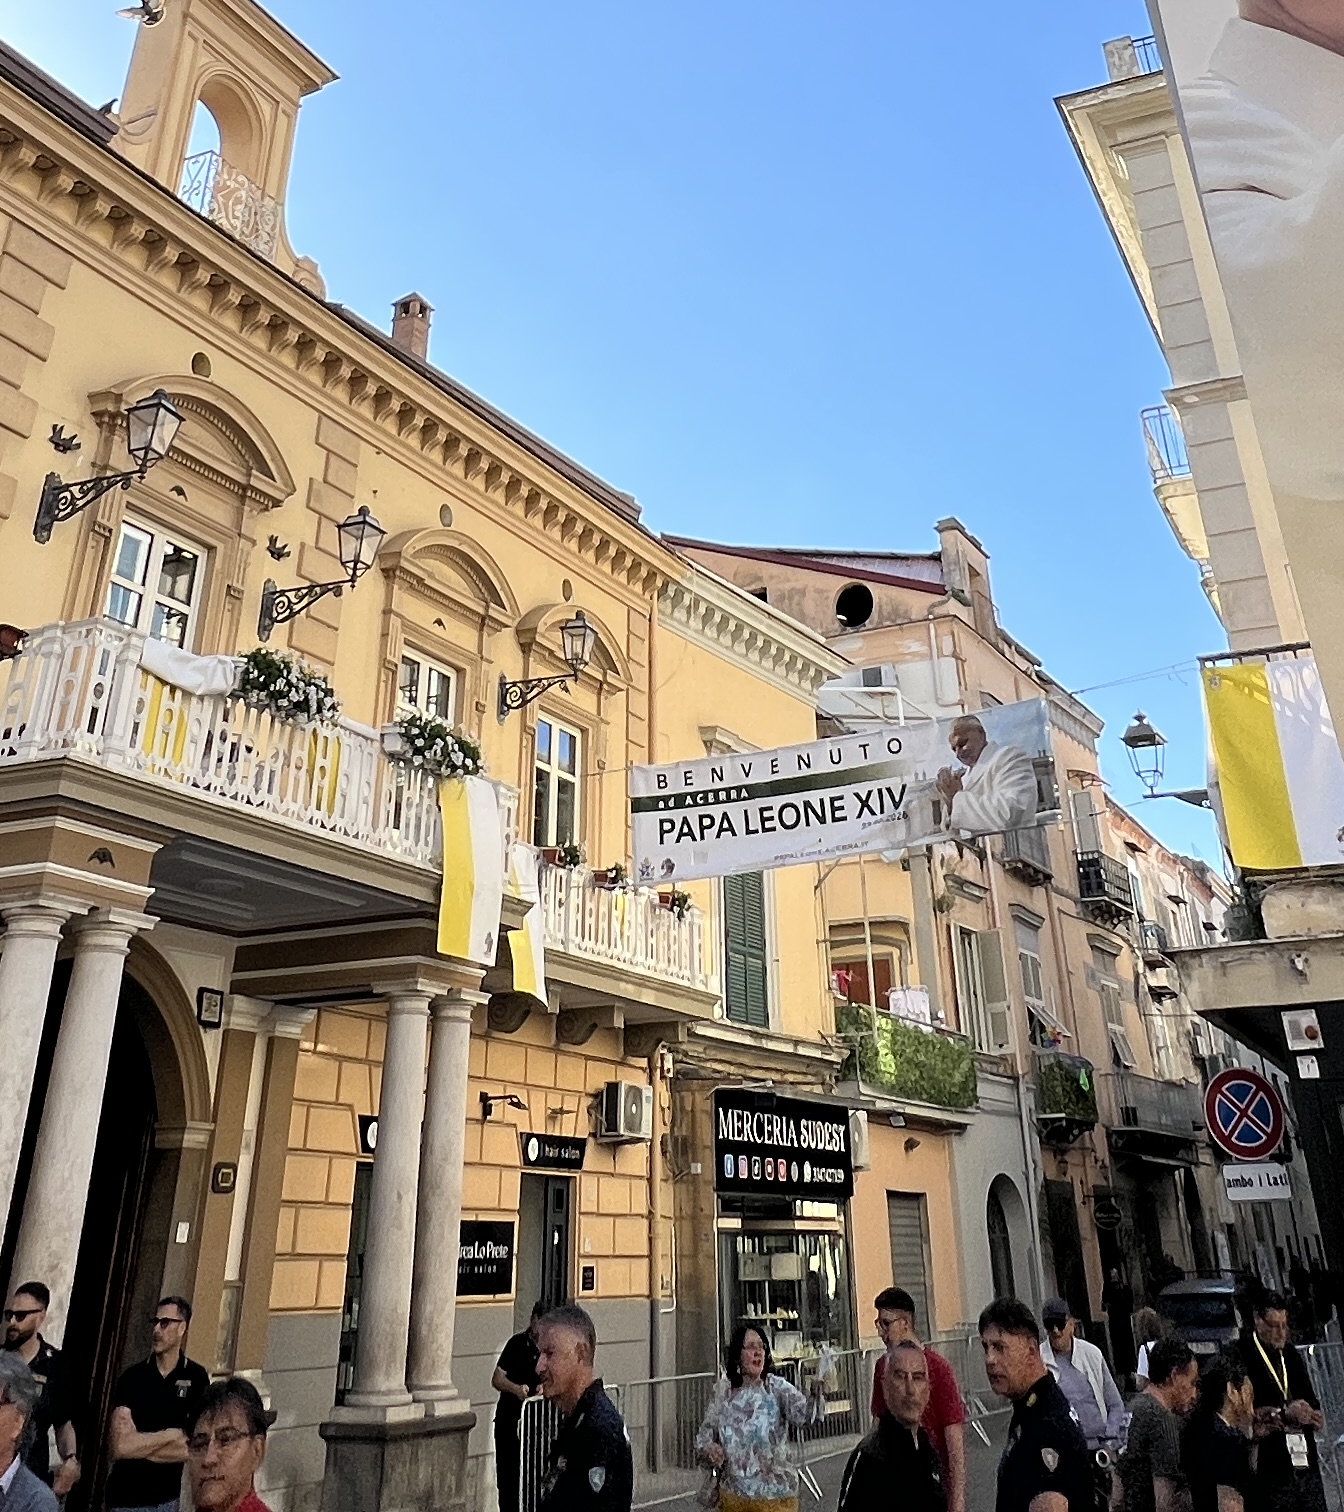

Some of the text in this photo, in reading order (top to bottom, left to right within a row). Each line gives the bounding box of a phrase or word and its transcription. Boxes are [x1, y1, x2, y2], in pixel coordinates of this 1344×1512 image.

[656, 737, 902, 790] BENVENUTO
[658, 787, 749, 810] ad ACERRA
[658, 783, 907, 845] PAPA LEONE XIV
[718, 1107, 846, 1152] MERCERIA SUDEST
[475, 1241, 486, 1259] Lo
[487, 1241, 509, 1259] Prete
